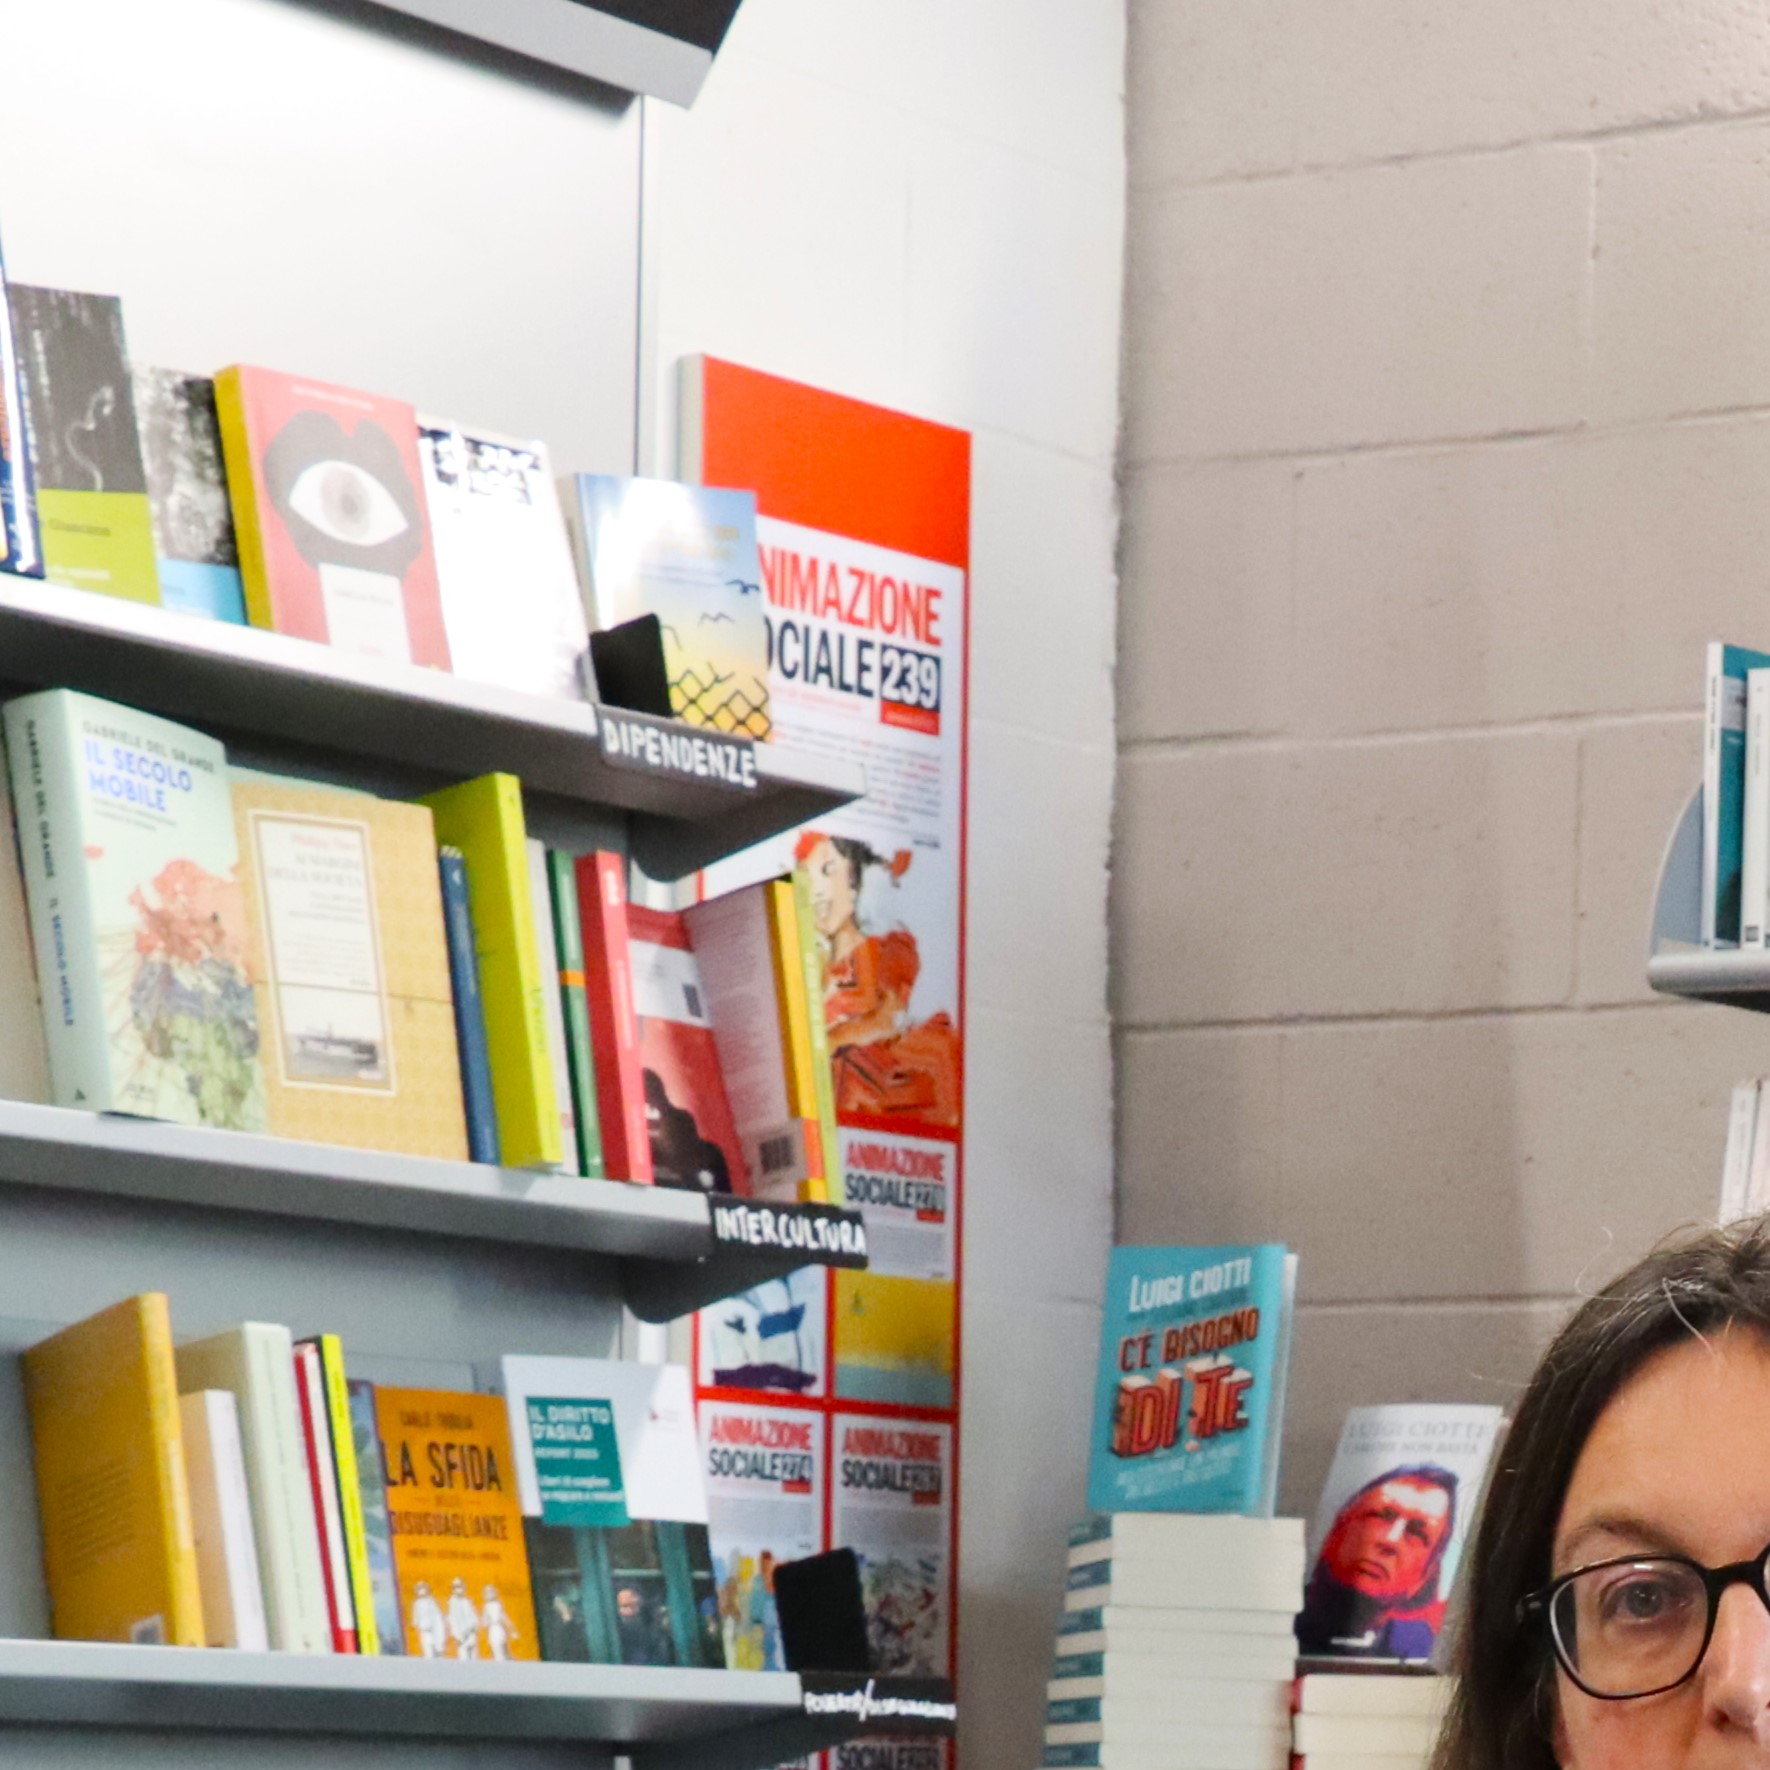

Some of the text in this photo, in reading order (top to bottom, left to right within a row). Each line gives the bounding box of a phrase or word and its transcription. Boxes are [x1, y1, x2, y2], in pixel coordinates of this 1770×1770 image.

[757, 543, 942, 647] NIMAZIONE
[765, 615, 940, 710] CIALE 239
[83, 740, 194, 793] IL SECOLO
[145, 737, 168, 757] DEL
[602, 717, 758, 789] DIPENDENZE
[88, 770, 168, 813] MOBILE
[846, 1140, 945, 1182] ANIMAZIONE
[845, 1173, 915, 1210] SOCIALE
[715, 1206, 867, 1256] INTERCULTURA
[1129, 1257, 1252, 1313] LUIGI CIOTTI
[1162, 1305, 1261, 1364] BISOGNO
[709, 1413, 812, 1450] ANIMAZIONE
[1112, 1354, 1256, 1459] DI TE
[382, 1440, 418, 1487] LA
[427, 1441, 502, 1492] SFIDA
[709, 1447, 780, 1479] SOCIALE
[842, 1426, 942, 1462] ANIMAZIONE
[841, 1458, 911, 1492] SOCIALE
